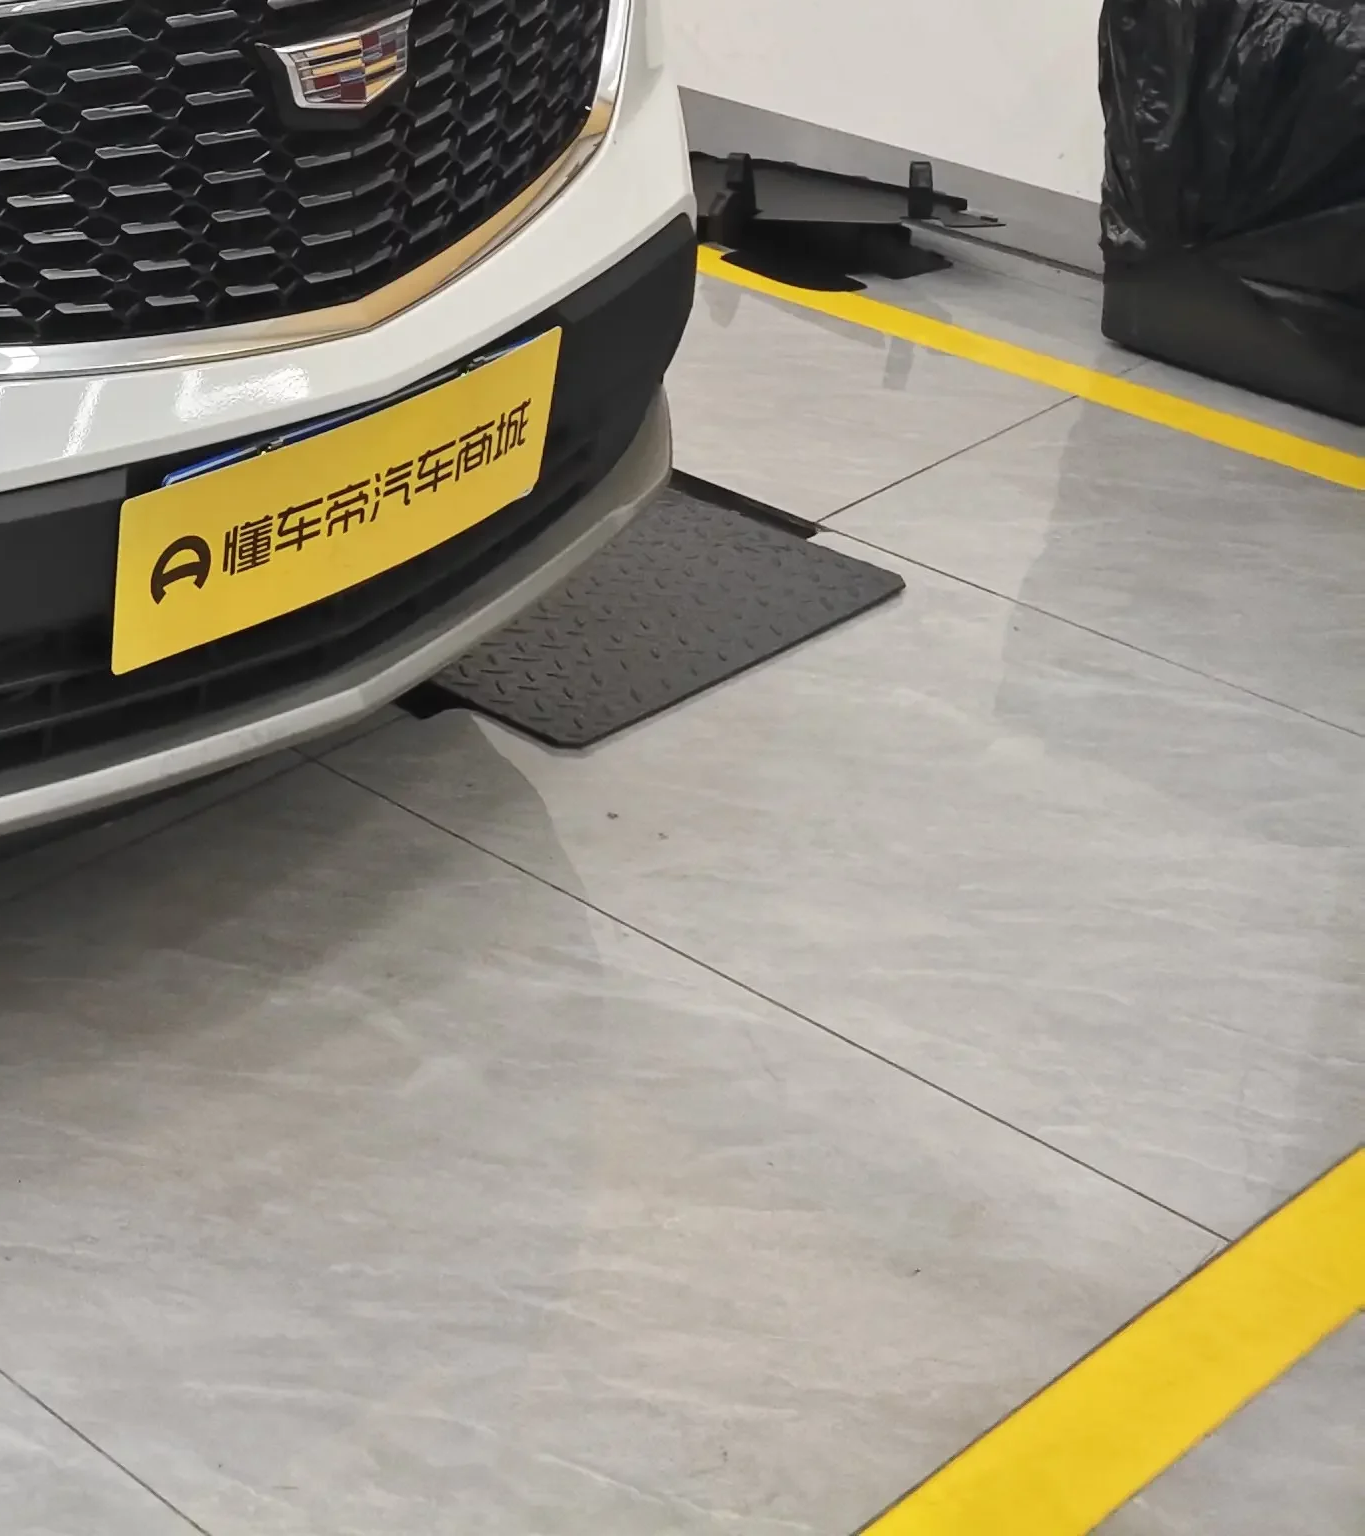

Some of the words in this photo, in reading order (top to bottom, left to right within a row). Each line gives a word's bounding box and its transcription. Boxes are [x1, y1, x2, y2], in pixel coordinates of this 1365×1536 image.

[223, 398, 530, 575] 懂车帝汽车商城
